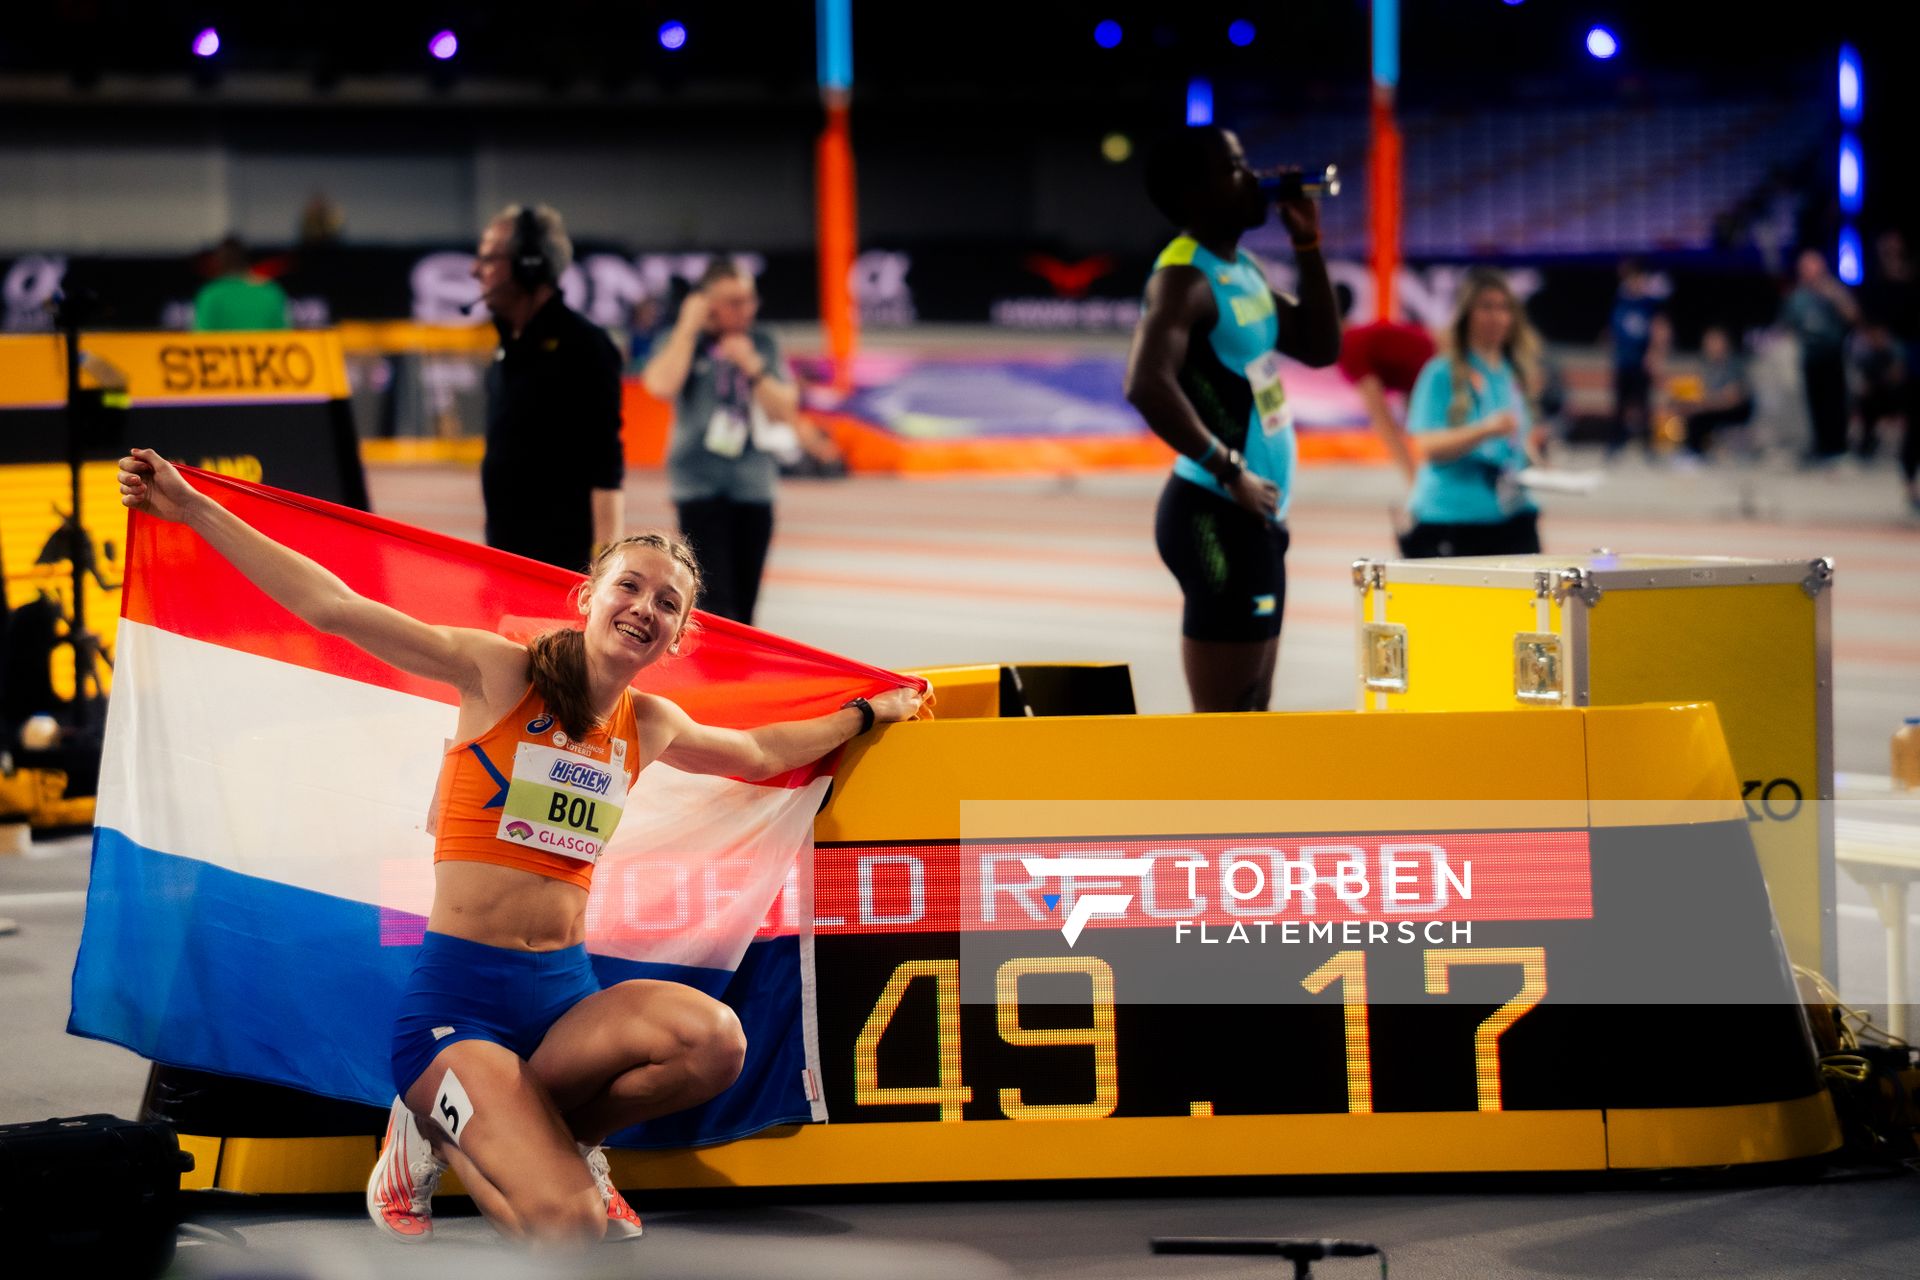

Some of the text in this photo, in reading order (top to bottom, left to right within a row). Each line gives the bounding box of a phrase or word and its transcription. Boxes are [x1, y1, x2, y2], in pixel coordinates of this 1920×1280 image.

[159, 343, 315, 391] SEIKO
[549, 759, 612, 795] HI-CHEW
[547, 791, 599, 833] BOL
[586, 842, 1449, 930] ORLD RECORD
[440, 1092, 460, 1135] 5
